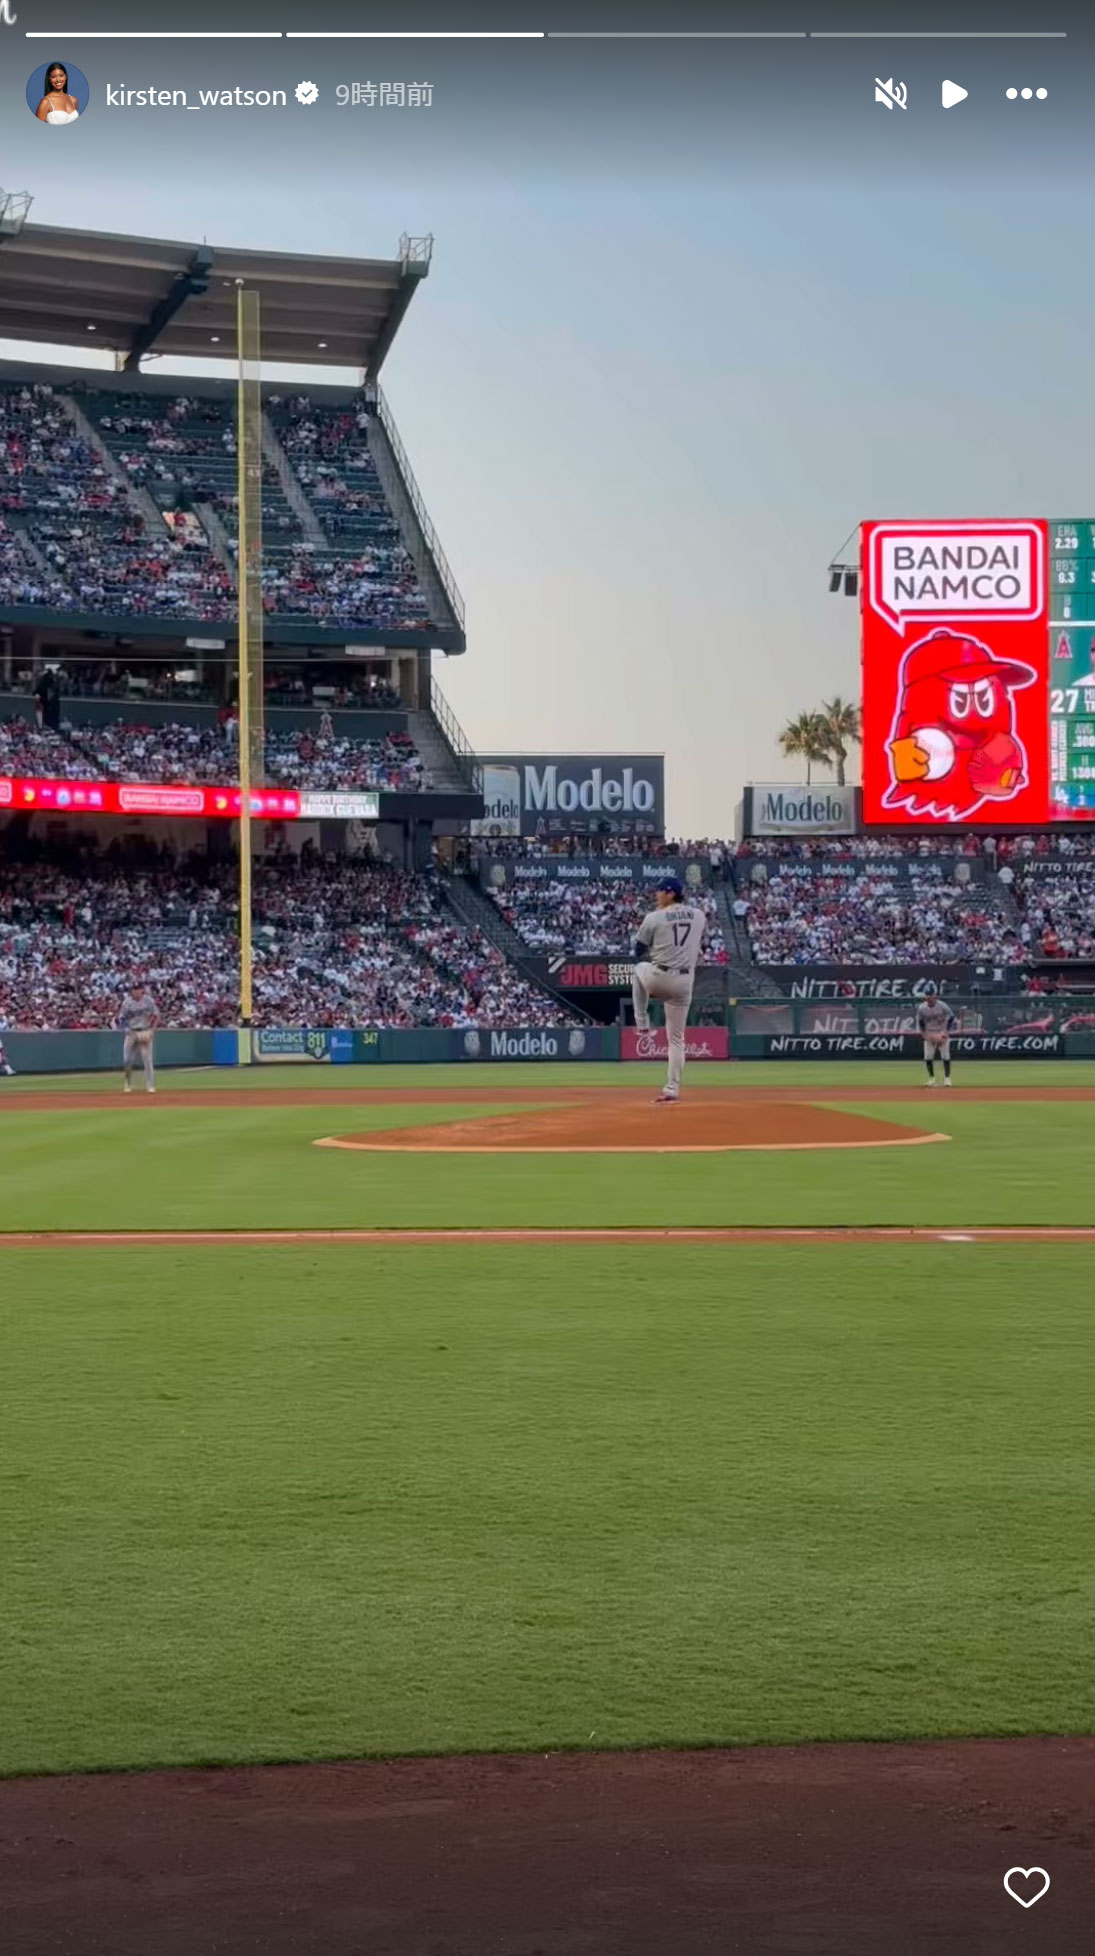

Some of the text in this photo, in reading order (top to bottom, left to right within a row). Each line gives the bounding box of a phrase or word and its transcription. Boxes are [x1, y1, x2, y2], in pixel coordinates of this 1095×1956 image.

[894, 545, 1019, 570] BANDAI
[894, 574, 1021, 599] NAMCO
[1050, 688, 1079, 713] 27
[524, 765, 655, 812] Modelo
[484, 798, 519, 819] odelo
[767, 793, 842, 821] Modelo
[514, 865, 547, 877] Modelo
[557, 865, 590, 877] Modelo
[600, 865, 632, 877] Modelo
[643, 865, 676, 877] Modelo
[1024, 860, 1062, 873] NITTO
[672, 922, 691, 947] 17
[560, 964, 607, 986] JMG
[261, 1030, 304, 1043] Contact
[307, 1030, 326, 1048] 811
[491, 1031, 558, 1056] Modelo
[770, 1035, 904, 1051] NITTO TIRE.COM
[980, 1035, 1059, 1051] TIRE.COM
